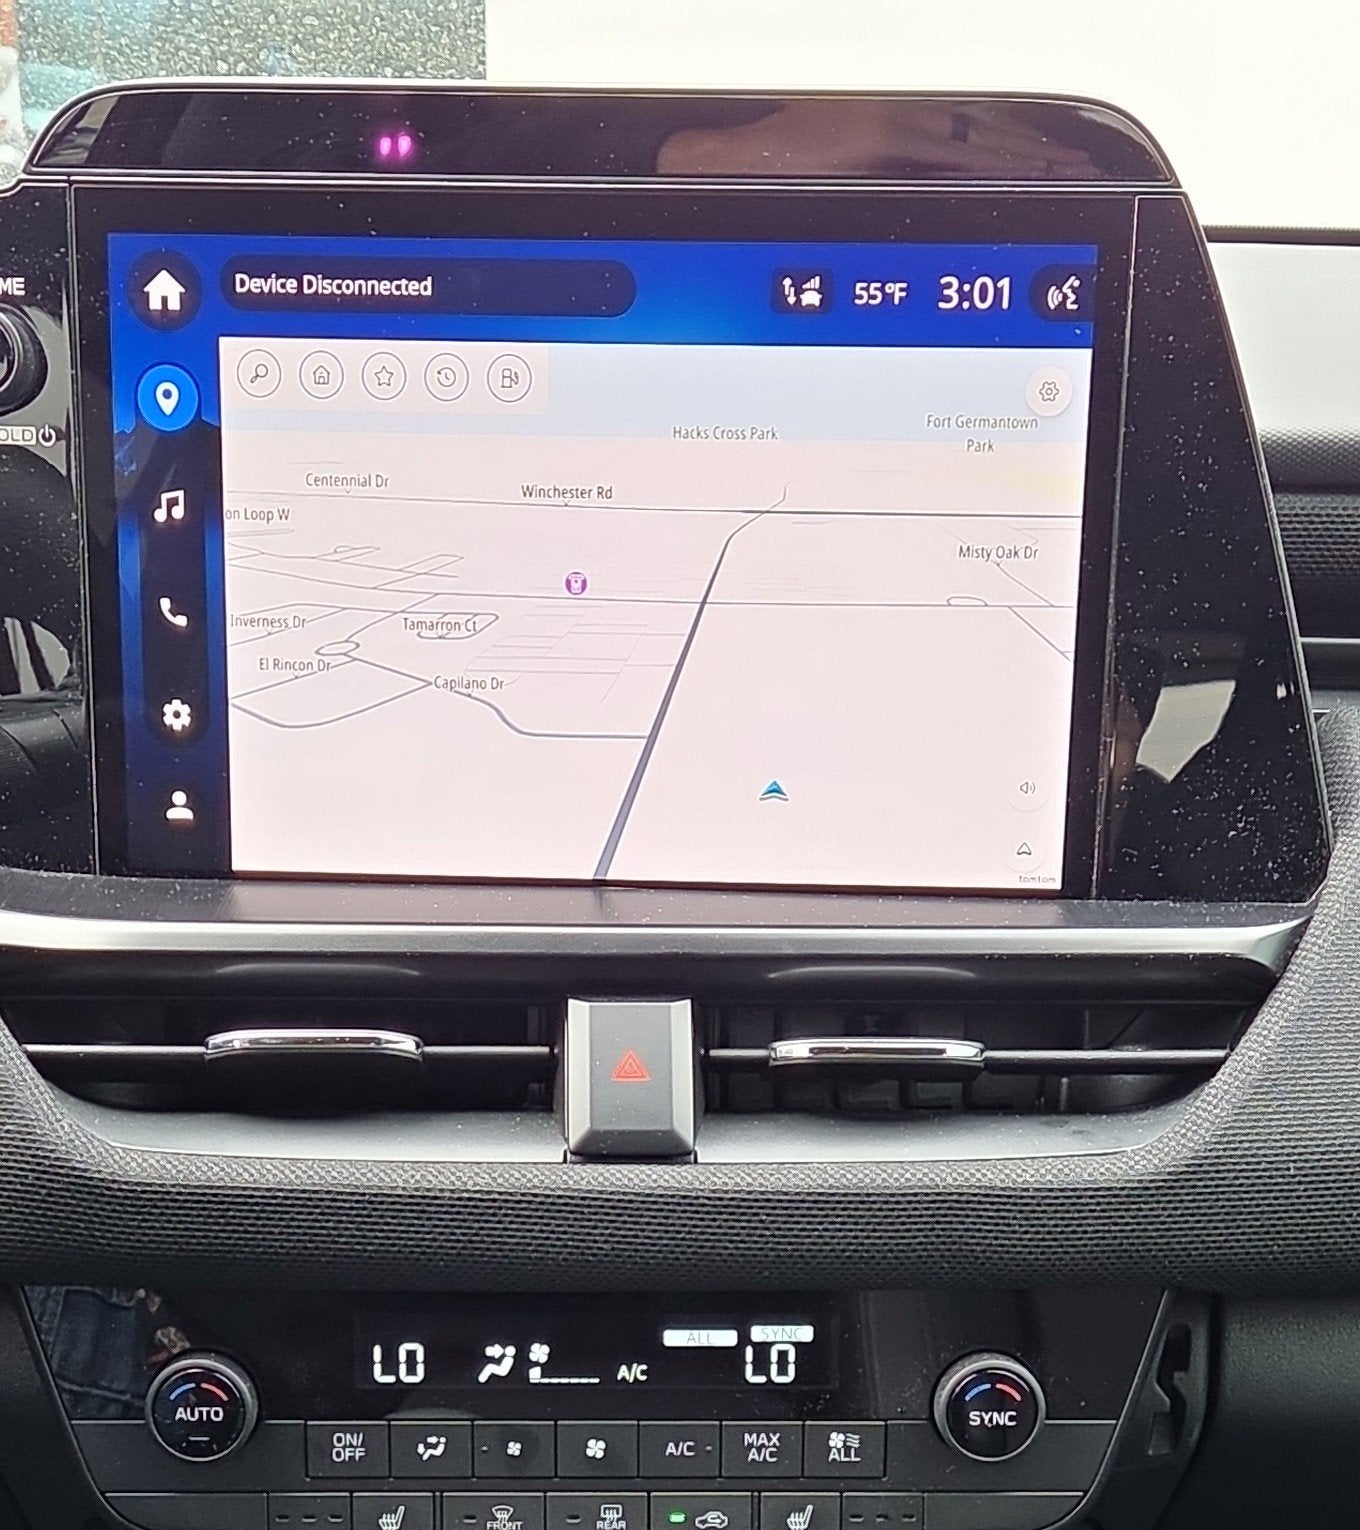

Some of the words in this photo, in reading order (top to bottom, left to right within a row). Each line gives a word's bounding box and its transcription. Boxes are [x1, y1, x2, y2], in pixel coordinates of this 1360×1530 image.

[234, 273, 297, 295] Device
[301, 274, 433, 297] Disconnected
[937, 275, 1011, 310] 3:01
[926, 414, 952, 430] Fort
[955, 414, 1039, 431] Germantown
[672, 425, 710, 441] Hacks
[713, 426, 747, 441] Cross
[750, 426, 779, 442] Park
[966, 438, 995, 454] Park
[305, 472, 373, 488] Centennial
[375, 473, 390, 489] Dr
[521, 485, 594, 500] Winchester
[597, 486, 613, 500] Rd
[243, 507, 275, 526] Loop
[276, 507, 291, 522] W
[958, 544, 992, 562] Misty
[995, 545, 1021, 560] Oak
[1024, 545, 1039, 561] Dr
[230, 614, 289, 629] Inverness
[291, 615, 307, 630] Dr
[403, 618, 462, 632] Tamarron
[463, 619, 477, 633] Ct
[259, 658, 270, 672] El
[272, 658, 315, 673] Rincon
[317, 659, 332, 673] Dr
[433, 676, 487, 694] Capilano
[490, 677, 505, 691] Dr
[760, 1326, 803, 1341] SYNC
[616, 1364, 648, 1382] A/C
[174, 1406, 224, 1422] AUTO
[968, 1411, 1018, 1427] SYNC
[332, 1432, 364, 1447] ON/
[743, 1432, 781, 1447] MAX
[332, 1447, 366, 1462] OFF
[665, 1441, 696, 1457] A/C
[746, 1447, 779, 1462] A/C
[828, 1447, 861, 1462] ALL
[595, 1520, 627, 1530] REAR
